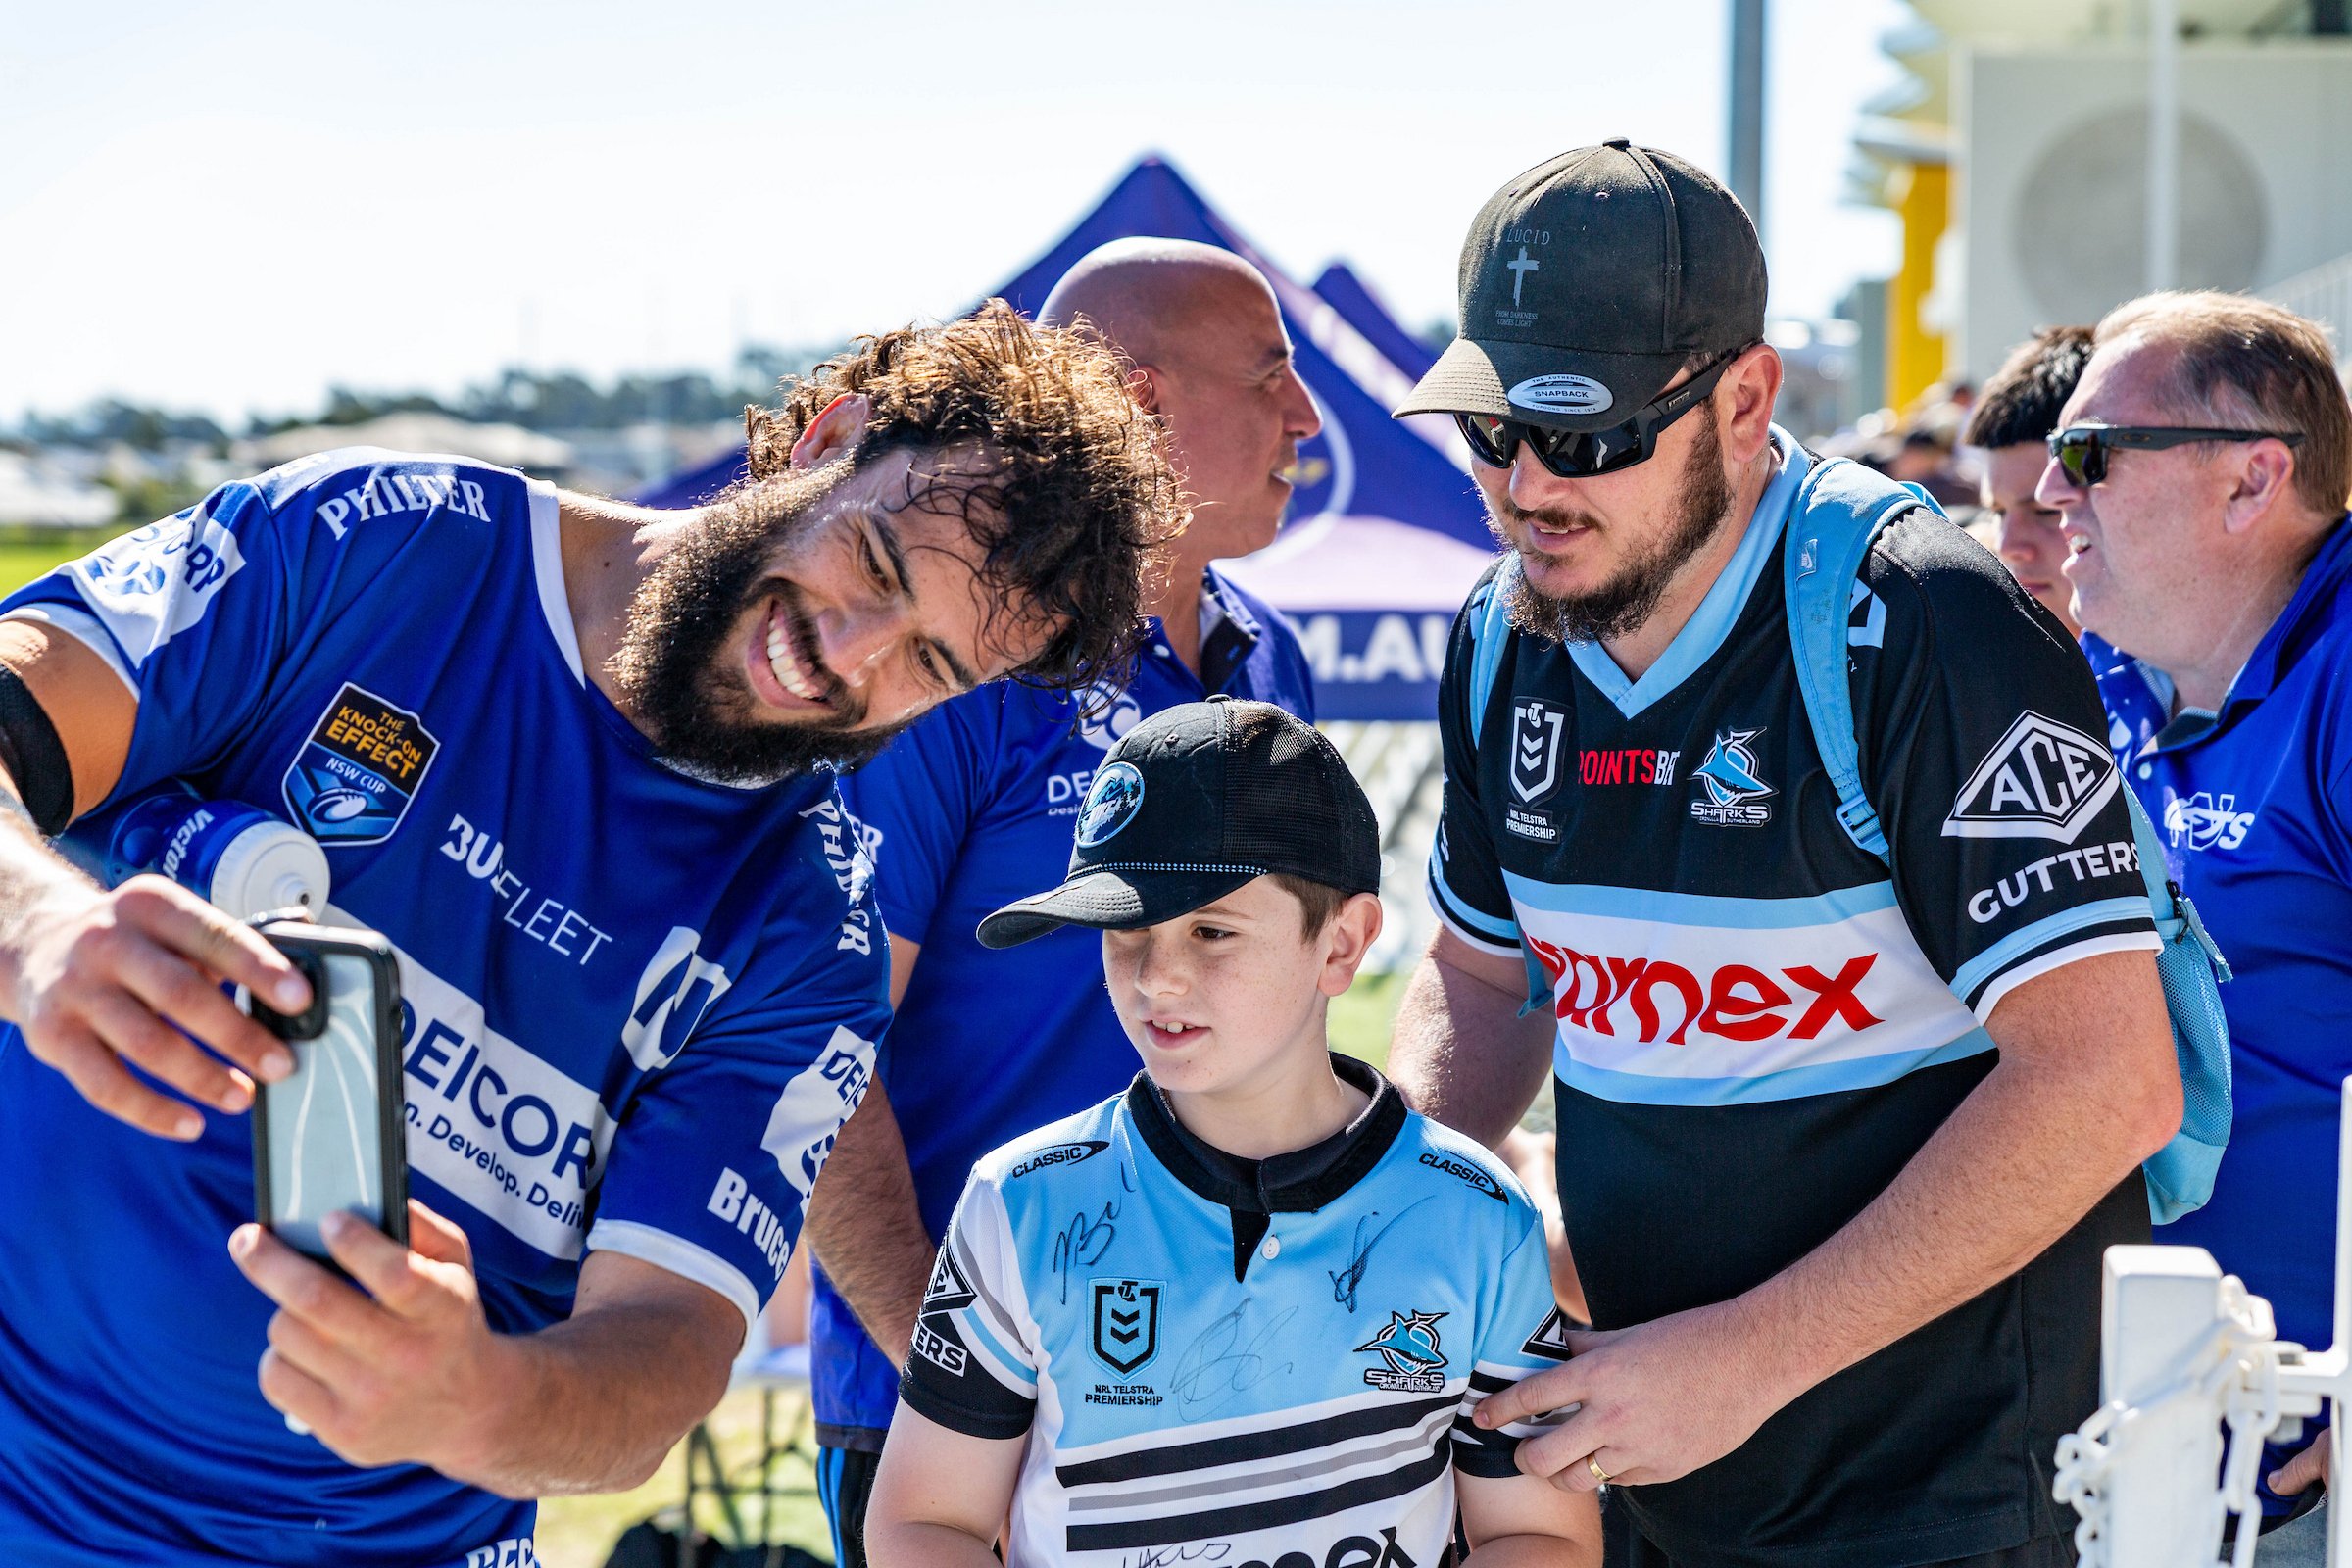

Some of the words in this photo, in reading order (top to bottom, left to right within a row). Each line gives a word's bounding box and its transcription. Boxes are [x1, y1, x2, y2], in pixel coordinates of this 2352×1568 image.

[1506, 227, 1550, 245] LUCID
[316, 474, 492, 541] PHILTER
[338, 705, 422, 763] KNOCK-ON
[378, 710, 406, 731] THE
[325, 719, 416, 779] EFFECT
[325, 757, 360, 780] NSW
[360, 774, 387, 794] CUP
[1577, 749, 1681, 785] OINTSBT
[1990, 731, 2096, 817] ACE
[1506, 817, 1556, 840] PREMIERSHIP
[1509, 808, 1520, 821] NRL
[1520, 812, 1548, 826] TELSTRA
[1690, 802, 1768, 824] SHARKS
[439, 812, 613, 966] BUFLEET
[427, 1114, 521, 1198] Develop.
[526, 1182, 586, 1229] Deliv
[1011, 1147, 1082, 1178] CLASSIC
[1418, 1152, 1490, 1188] CLASSIC
[1094, 1384, 1112, 1394] NRL
[1113, 1384, 1154, 1395] TELSTRA
[1365, 1370, 1444, 1391] SHARKS
[1085, 1393, 1163, 1406] PREMIERSHIP
